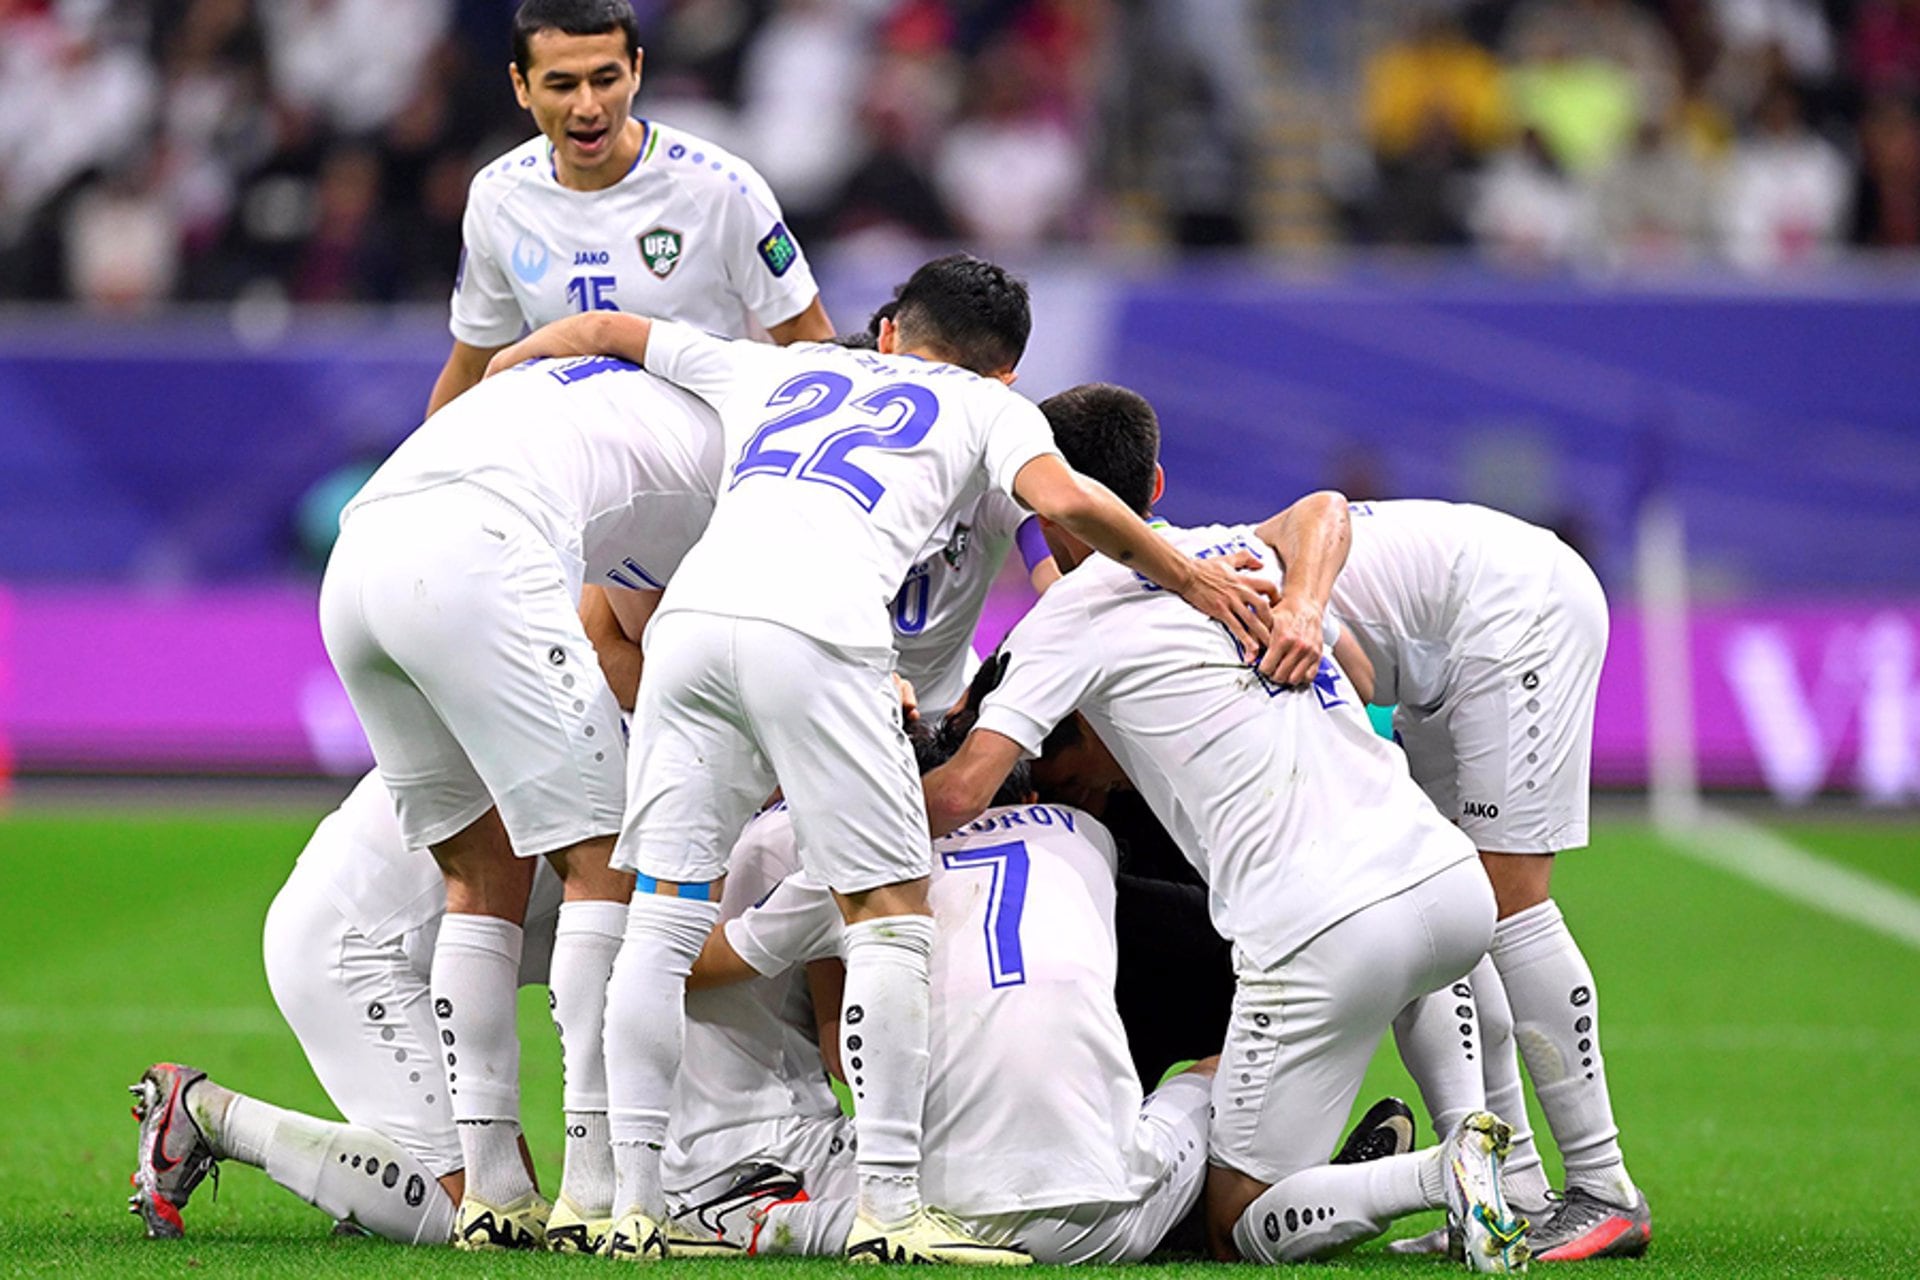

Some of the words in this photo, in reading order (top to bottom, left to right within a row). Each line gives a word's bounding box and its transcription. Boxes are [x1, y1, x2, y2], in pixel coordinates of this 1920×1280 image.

[573, 250, 610, 266] JAKO
[644, 235, 679, 256] UFA
[566, 275, 620, 313] 15
[728, 369, 941, 514] 22
[1463, 801, 1499, 819] JAKO
[941, 839, 1031, 989] 7
